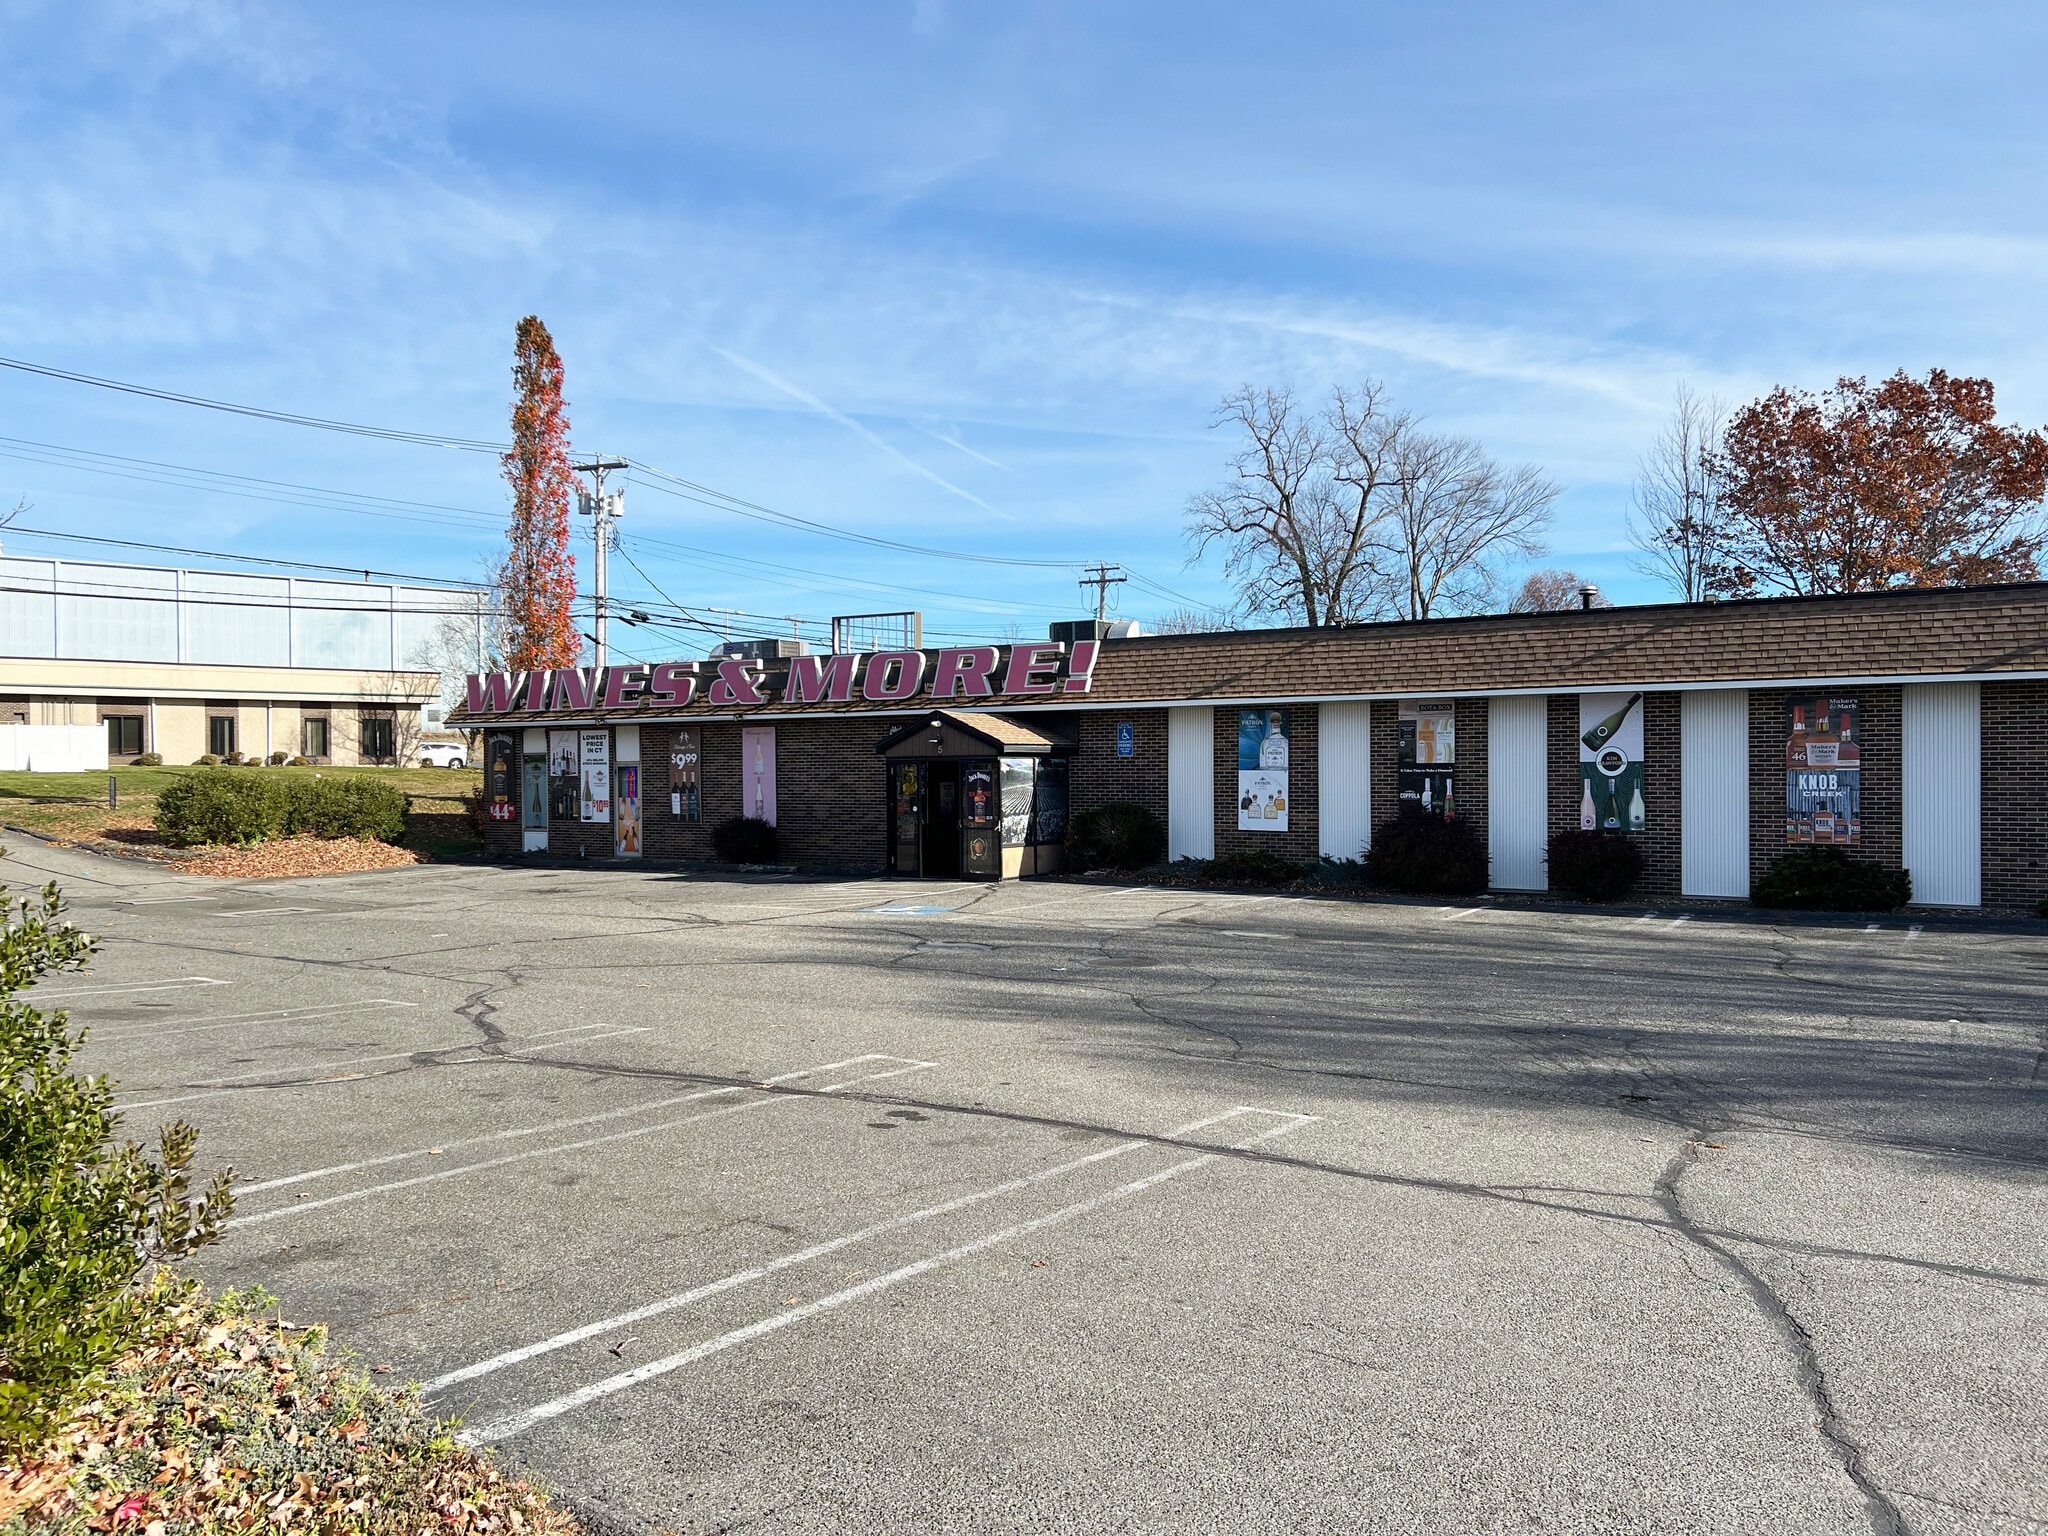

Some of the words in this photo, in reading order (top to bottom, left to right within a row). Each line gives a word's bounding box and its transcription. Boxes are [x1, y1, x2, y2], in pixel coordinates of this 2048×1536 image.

[466, 663, 699, 713] WINES
[709, 658, 769, 706] &
[784, 639, 1101, 704] MORE!
[937, 745, 943, 754] 5
[1791, 751, 1806, 761] 46
[1799, 774, 1838, 790] KNOB
